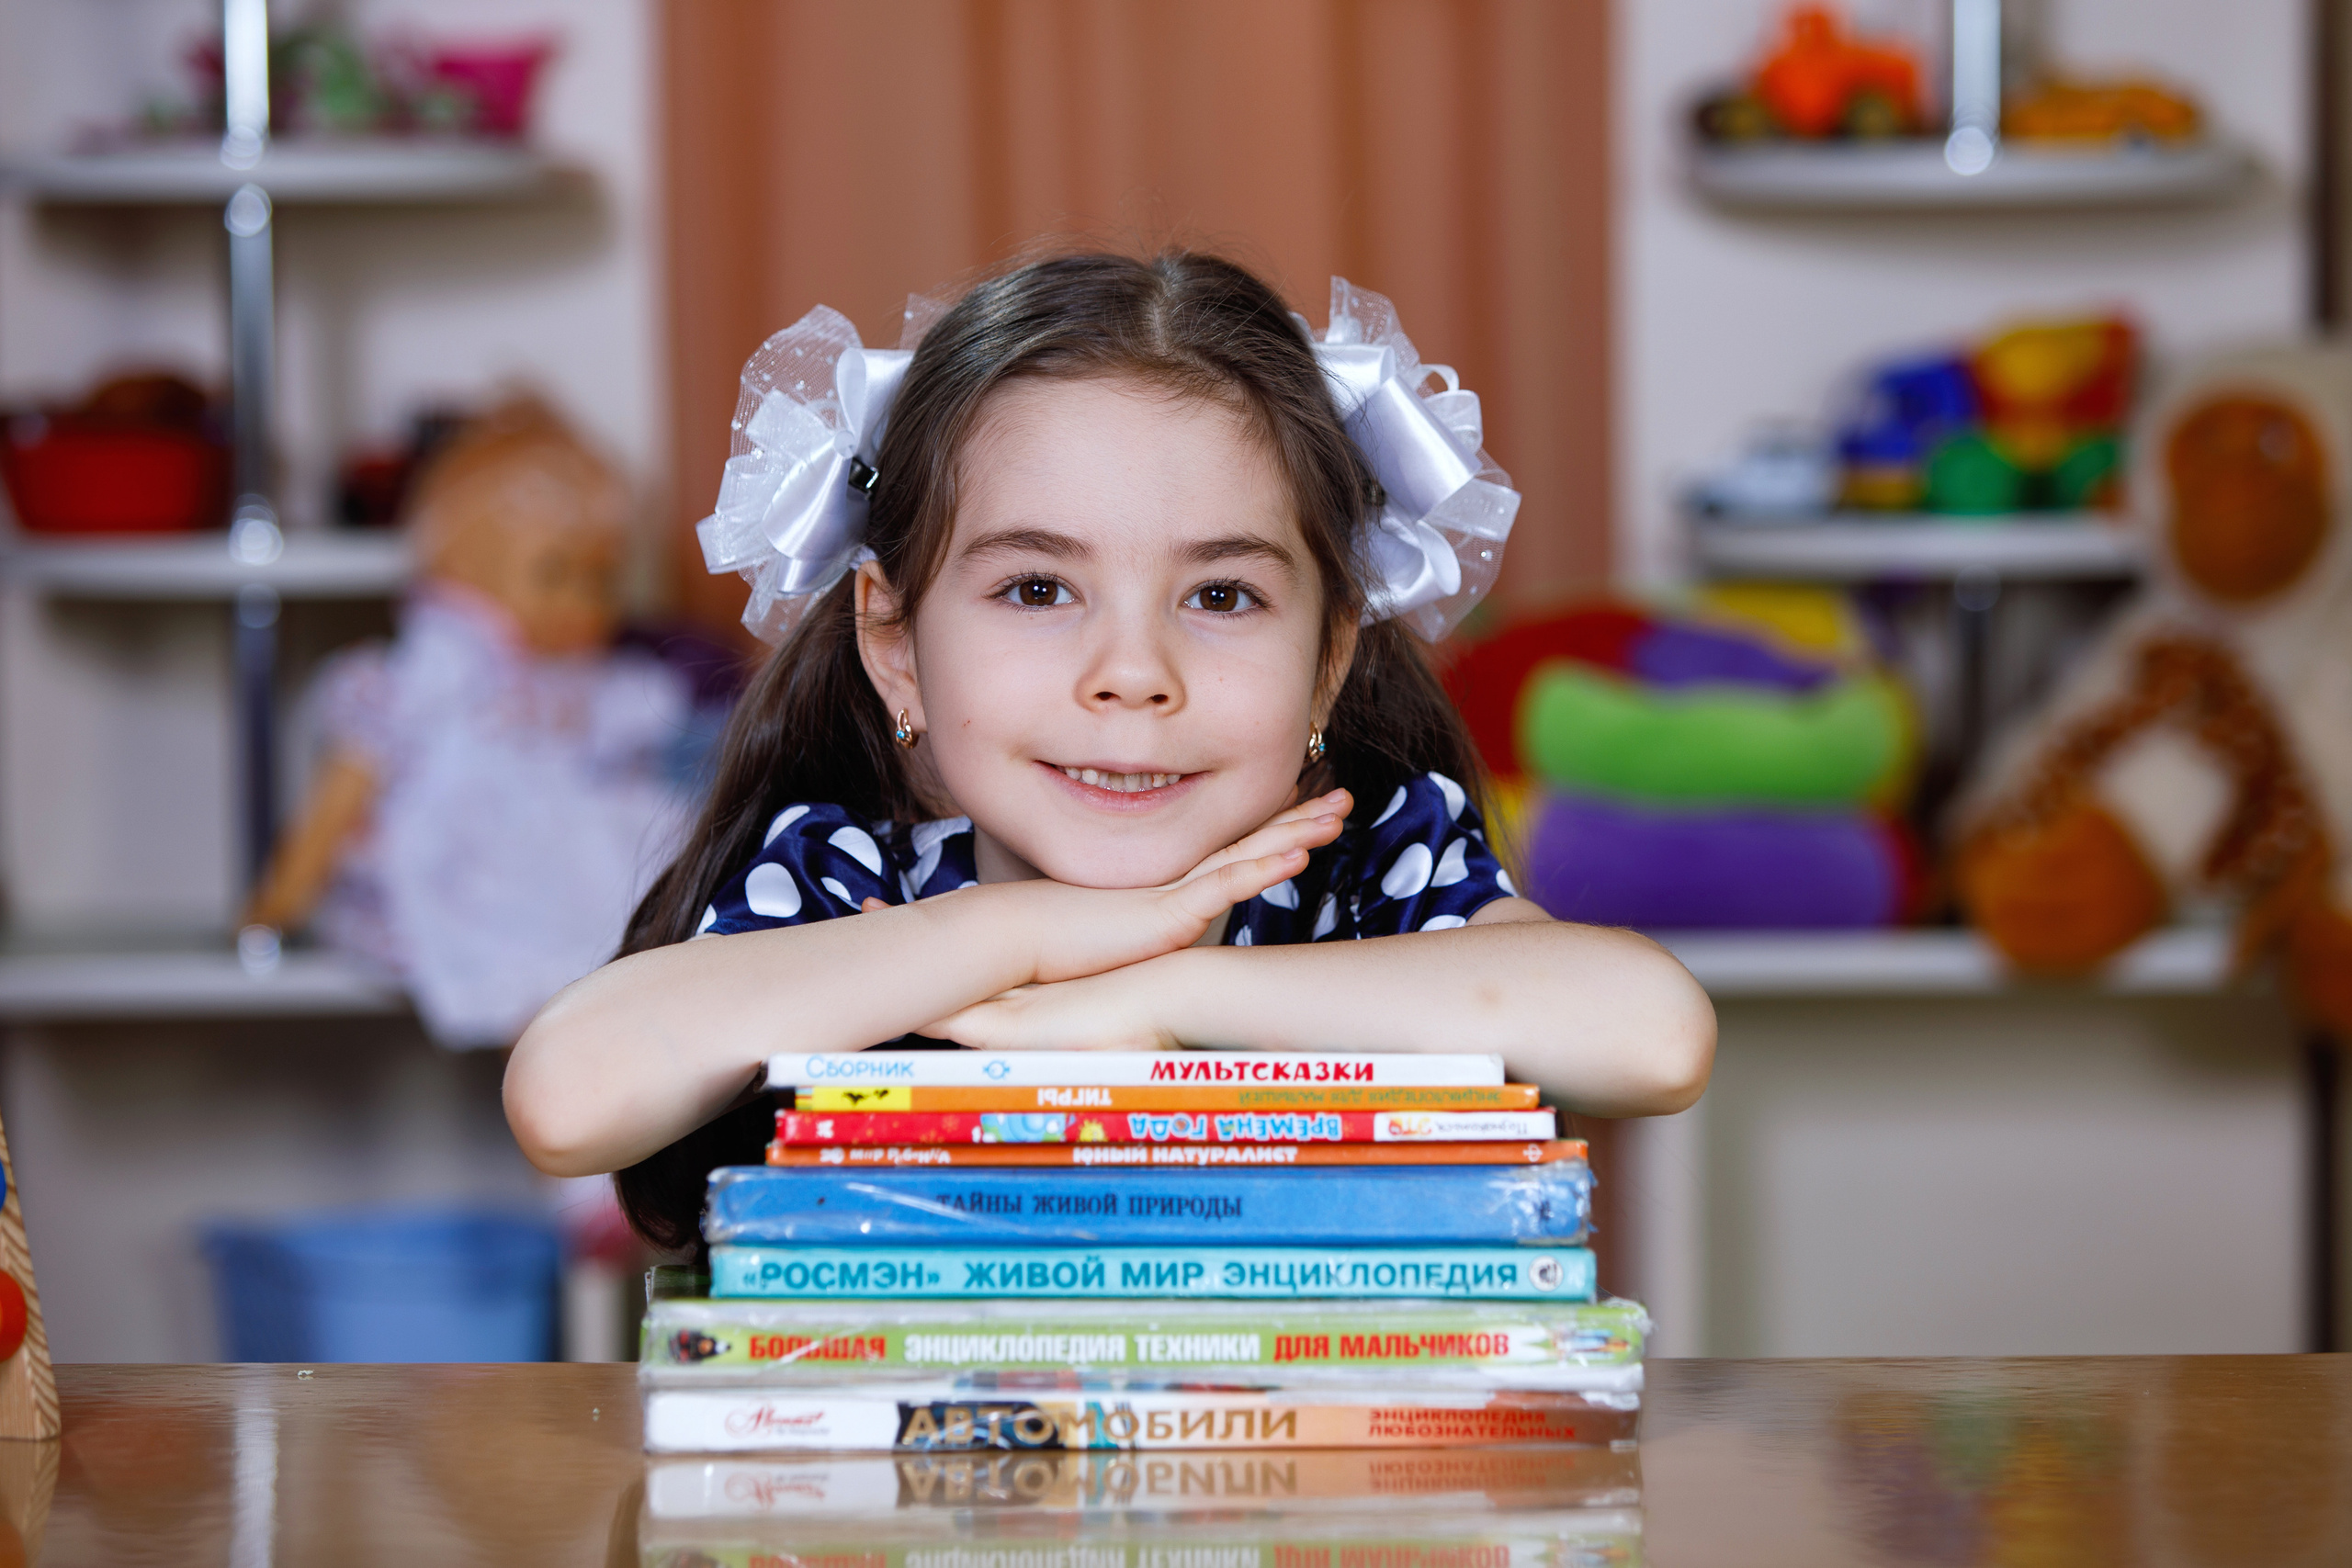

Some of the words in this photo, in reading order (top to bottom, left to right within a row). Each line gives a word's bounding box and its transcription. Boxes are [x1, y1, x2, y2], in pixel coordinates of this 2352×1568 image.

[1150, 1060, 1374, 1082] МУЛЬТСКАЗКИ
[1037, 1088, 1113, 1107] ТИГРЫ
[1127, 1112, 1206, 1141] ГОДА
[1215, 1113, 1343, 1142] ВРЕМЕНА
[1072, 1147, 1148, 1166] ЮНЫЙ
[1151, 1146, 1297, 1165] НАТУРАЛИСТ
[936, 1190, 1022, 1214] ТАЙНЫ
[1032, 1192, 1117, 1214] ЖИВОЙ
[1128, 1195, 1243, 1222] ПРИРОДЫ
[743, 1261, 941, 1290] «РОСМЭН»
[964, 1256, 1104, 1289] ЖИВОЙ
[1121, 1261, 1204, 1288] МИР
[1223, 1261, 1518, 1293] ЭНЦИКЛОПЕДИЯ
[749, 1336, 886, 1361] БОЛЬШАЯ
[904, 1334, 1126, 1364] ЭНЦИКЛОПЕДИЯ
[1134, 1334, 1261, 1361] ТЕХНИКИ
[1273, 1335, 1330, 1363] ДЛЯ
[1340, 1333, 1510, 1359] МАЛЬЧИКОВ
[901, 1407, 1298, 1446] АВТОМОБИЛИ
[1369, 1409, 1546, 1425] ЭНЦИКЛОПЕДИЯ
[1369, 1425, 1576, 1439] ЛЮБОЗНАТЕЛЬНЫХ
